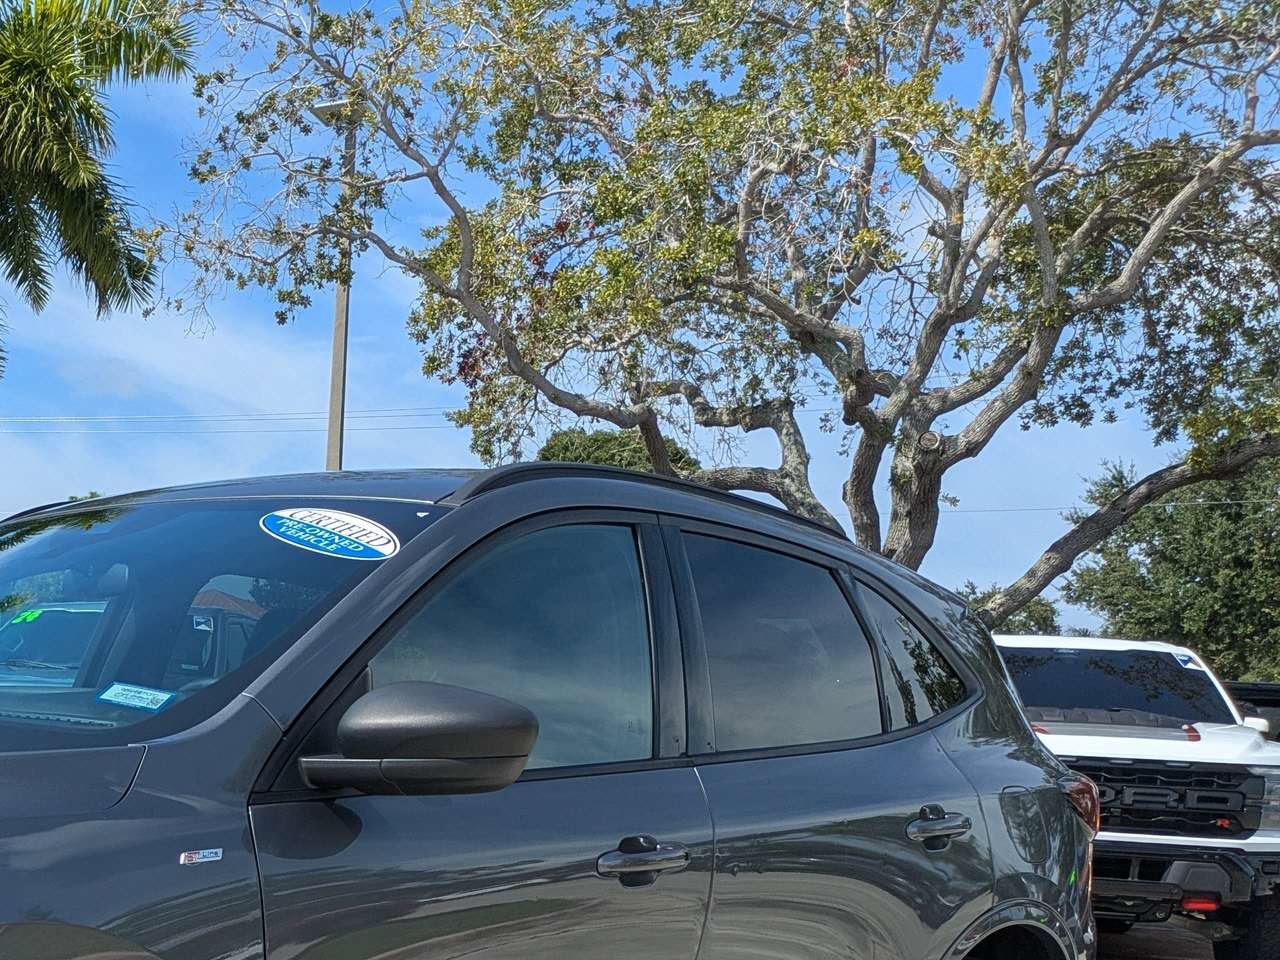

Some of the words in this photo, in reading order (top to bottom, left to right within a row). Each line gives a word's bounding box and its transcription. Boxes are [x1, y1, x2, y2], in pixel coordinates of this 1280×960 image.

[277, 518, 365, 552] PRE-OWNED
[279, 526, 337, 552] VEHICLE
[289, 510, 392, 547] CERTIFIED
